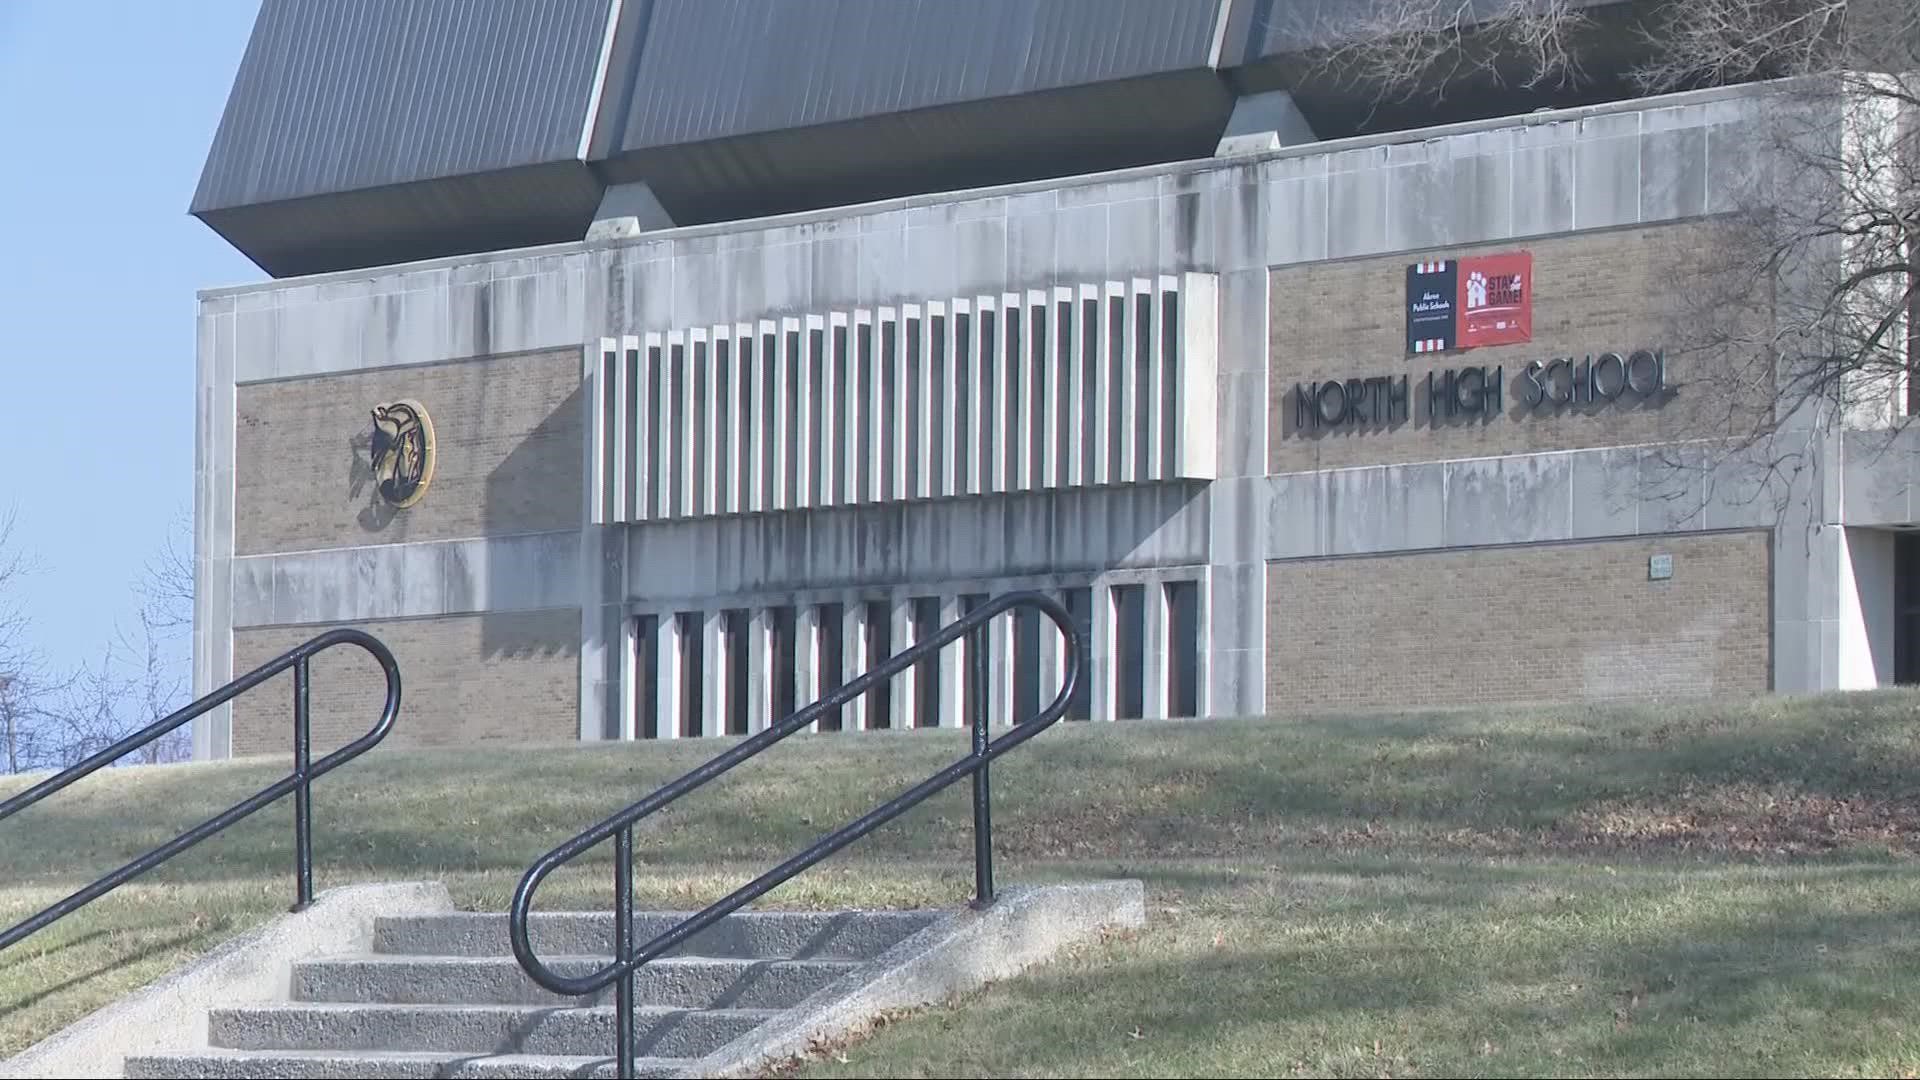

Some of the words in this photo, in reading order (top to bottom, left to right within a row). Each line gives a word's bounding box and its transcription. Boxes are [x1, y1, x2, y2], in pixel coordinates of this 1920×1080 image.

[1295, 373, 1409, 429] NORTH
[1427, 364, 1504, 418] HIGH
[1524, 349, 1669, 405] SCHOOL
